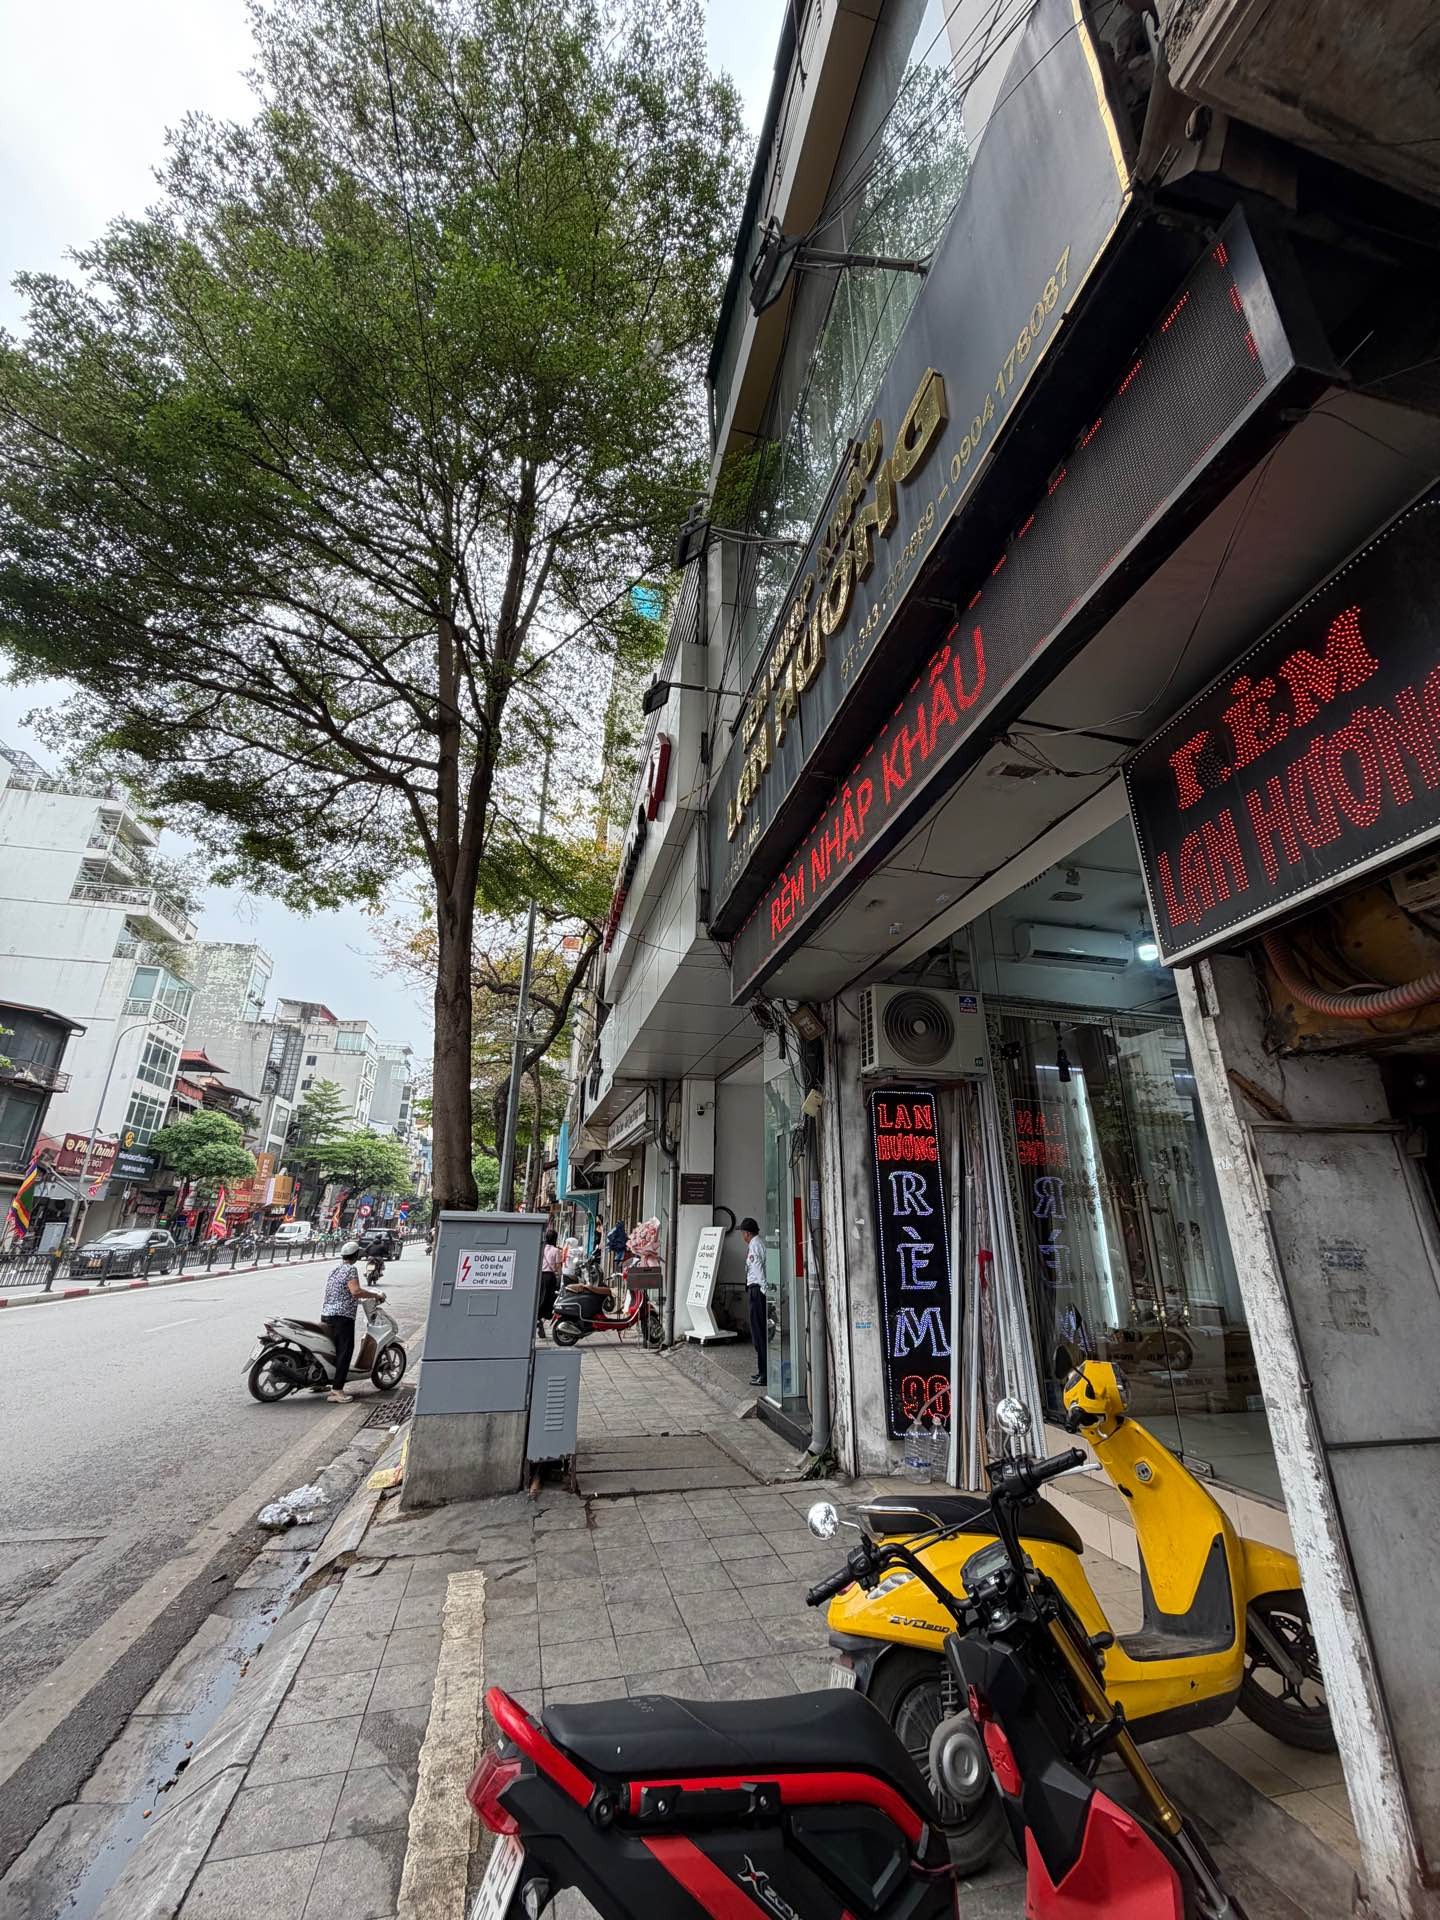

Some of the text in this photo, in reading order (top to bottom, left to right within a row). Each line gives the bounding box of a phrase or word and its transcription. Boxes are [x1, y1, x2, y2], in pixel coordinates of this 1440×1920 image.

[1168, 605, 1380, 811] RÈM
[727, 721, 772, 842] LAN
[770, 865, 806, 941] RÈM
[811, 777, 874, 893] NHẬP
[1157, 808, 1250, 927] LAN
[876, 1133, 937, 1161] HƯƠNG
[877, 1103, 932, 1129] LAN
[888, 1171, 952, 1357] RÈM
